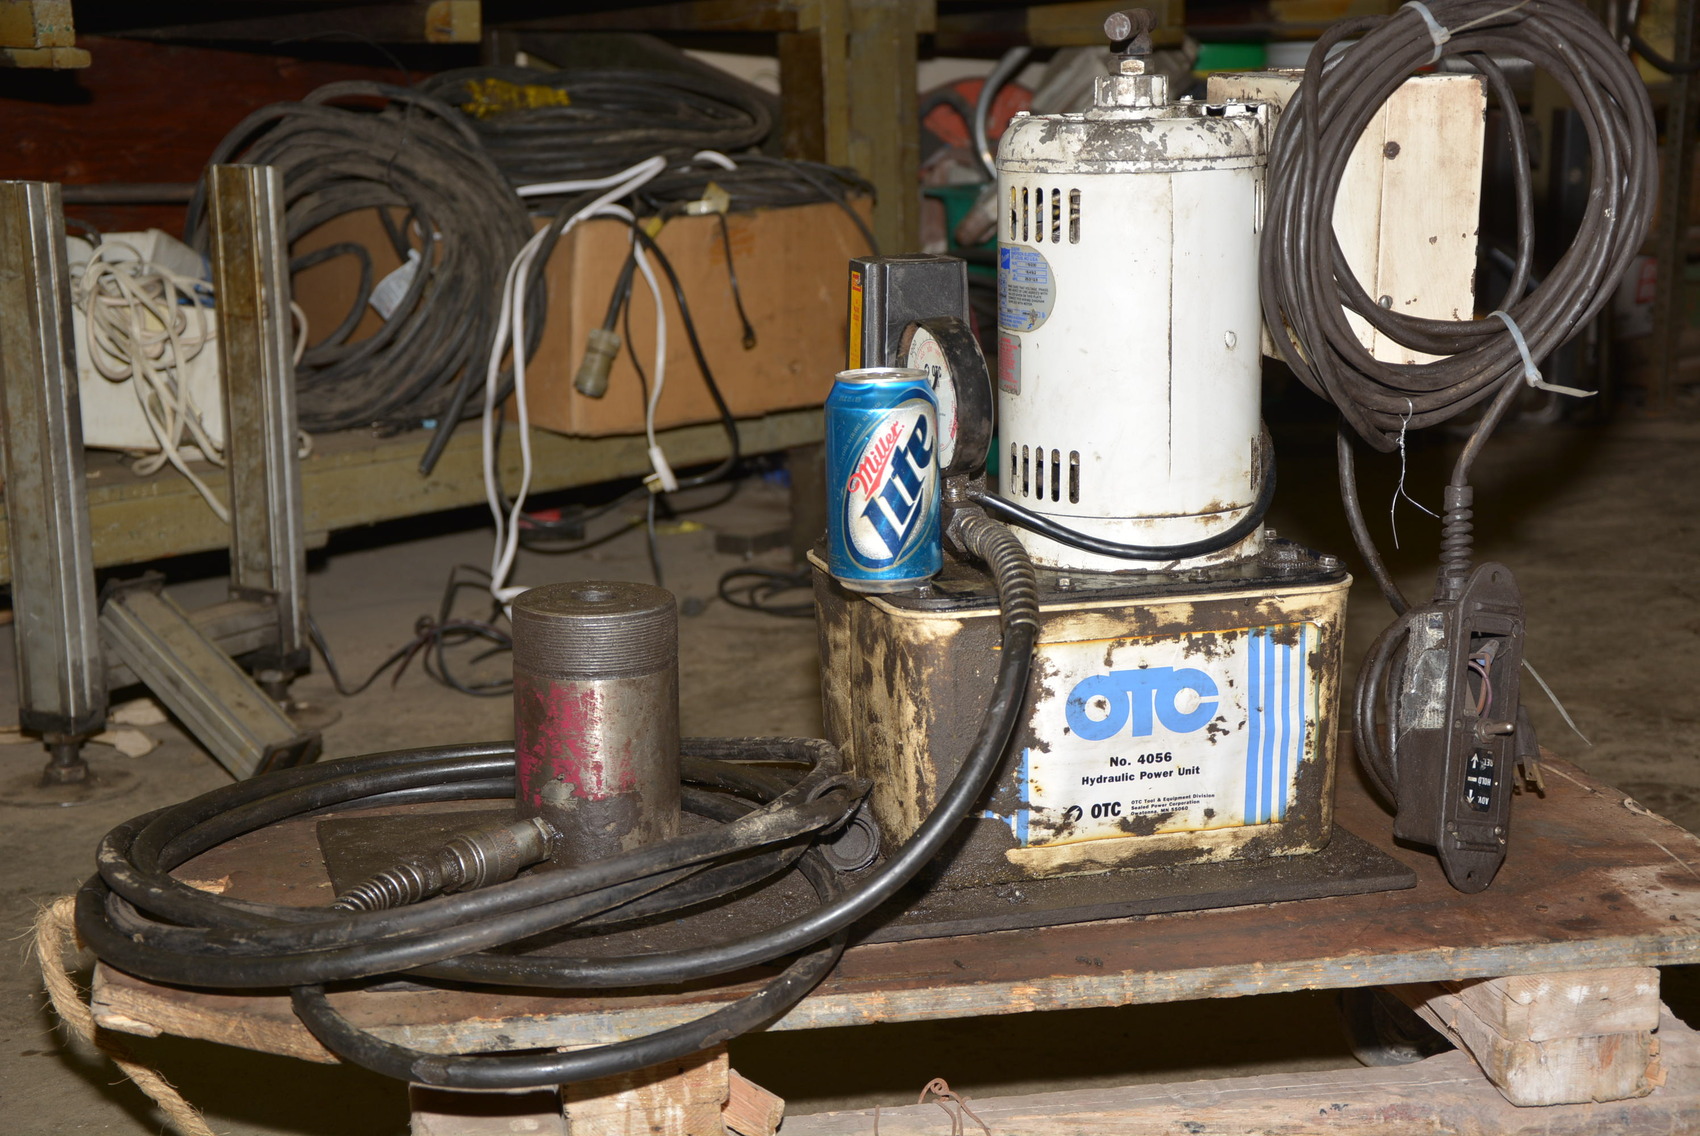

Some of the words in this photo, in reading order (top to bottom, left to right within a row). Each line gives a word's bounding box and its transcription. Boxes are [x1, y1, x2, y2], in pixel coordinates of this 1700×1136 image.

[847, 421, 903, 499] Miller
[860, 413, 935, 564] Lite
[1065, 666, 1219, 741] OTC
[1110, 756, 1131, 767] No.
[1137, 751, 1172, 765] 4056
[1081, 772, 1135, 787] Hydraulic
[1139, 769, 1174, 781] Power
[1177, 765, 1200, 776] Unit
[1477, 776, 1492, 786] HOLD
[1163, 794, 1191, 802] Equipment
[1168, 799, 1200, 807] Corporation
[1091, 801, 1122, 819] OTC
